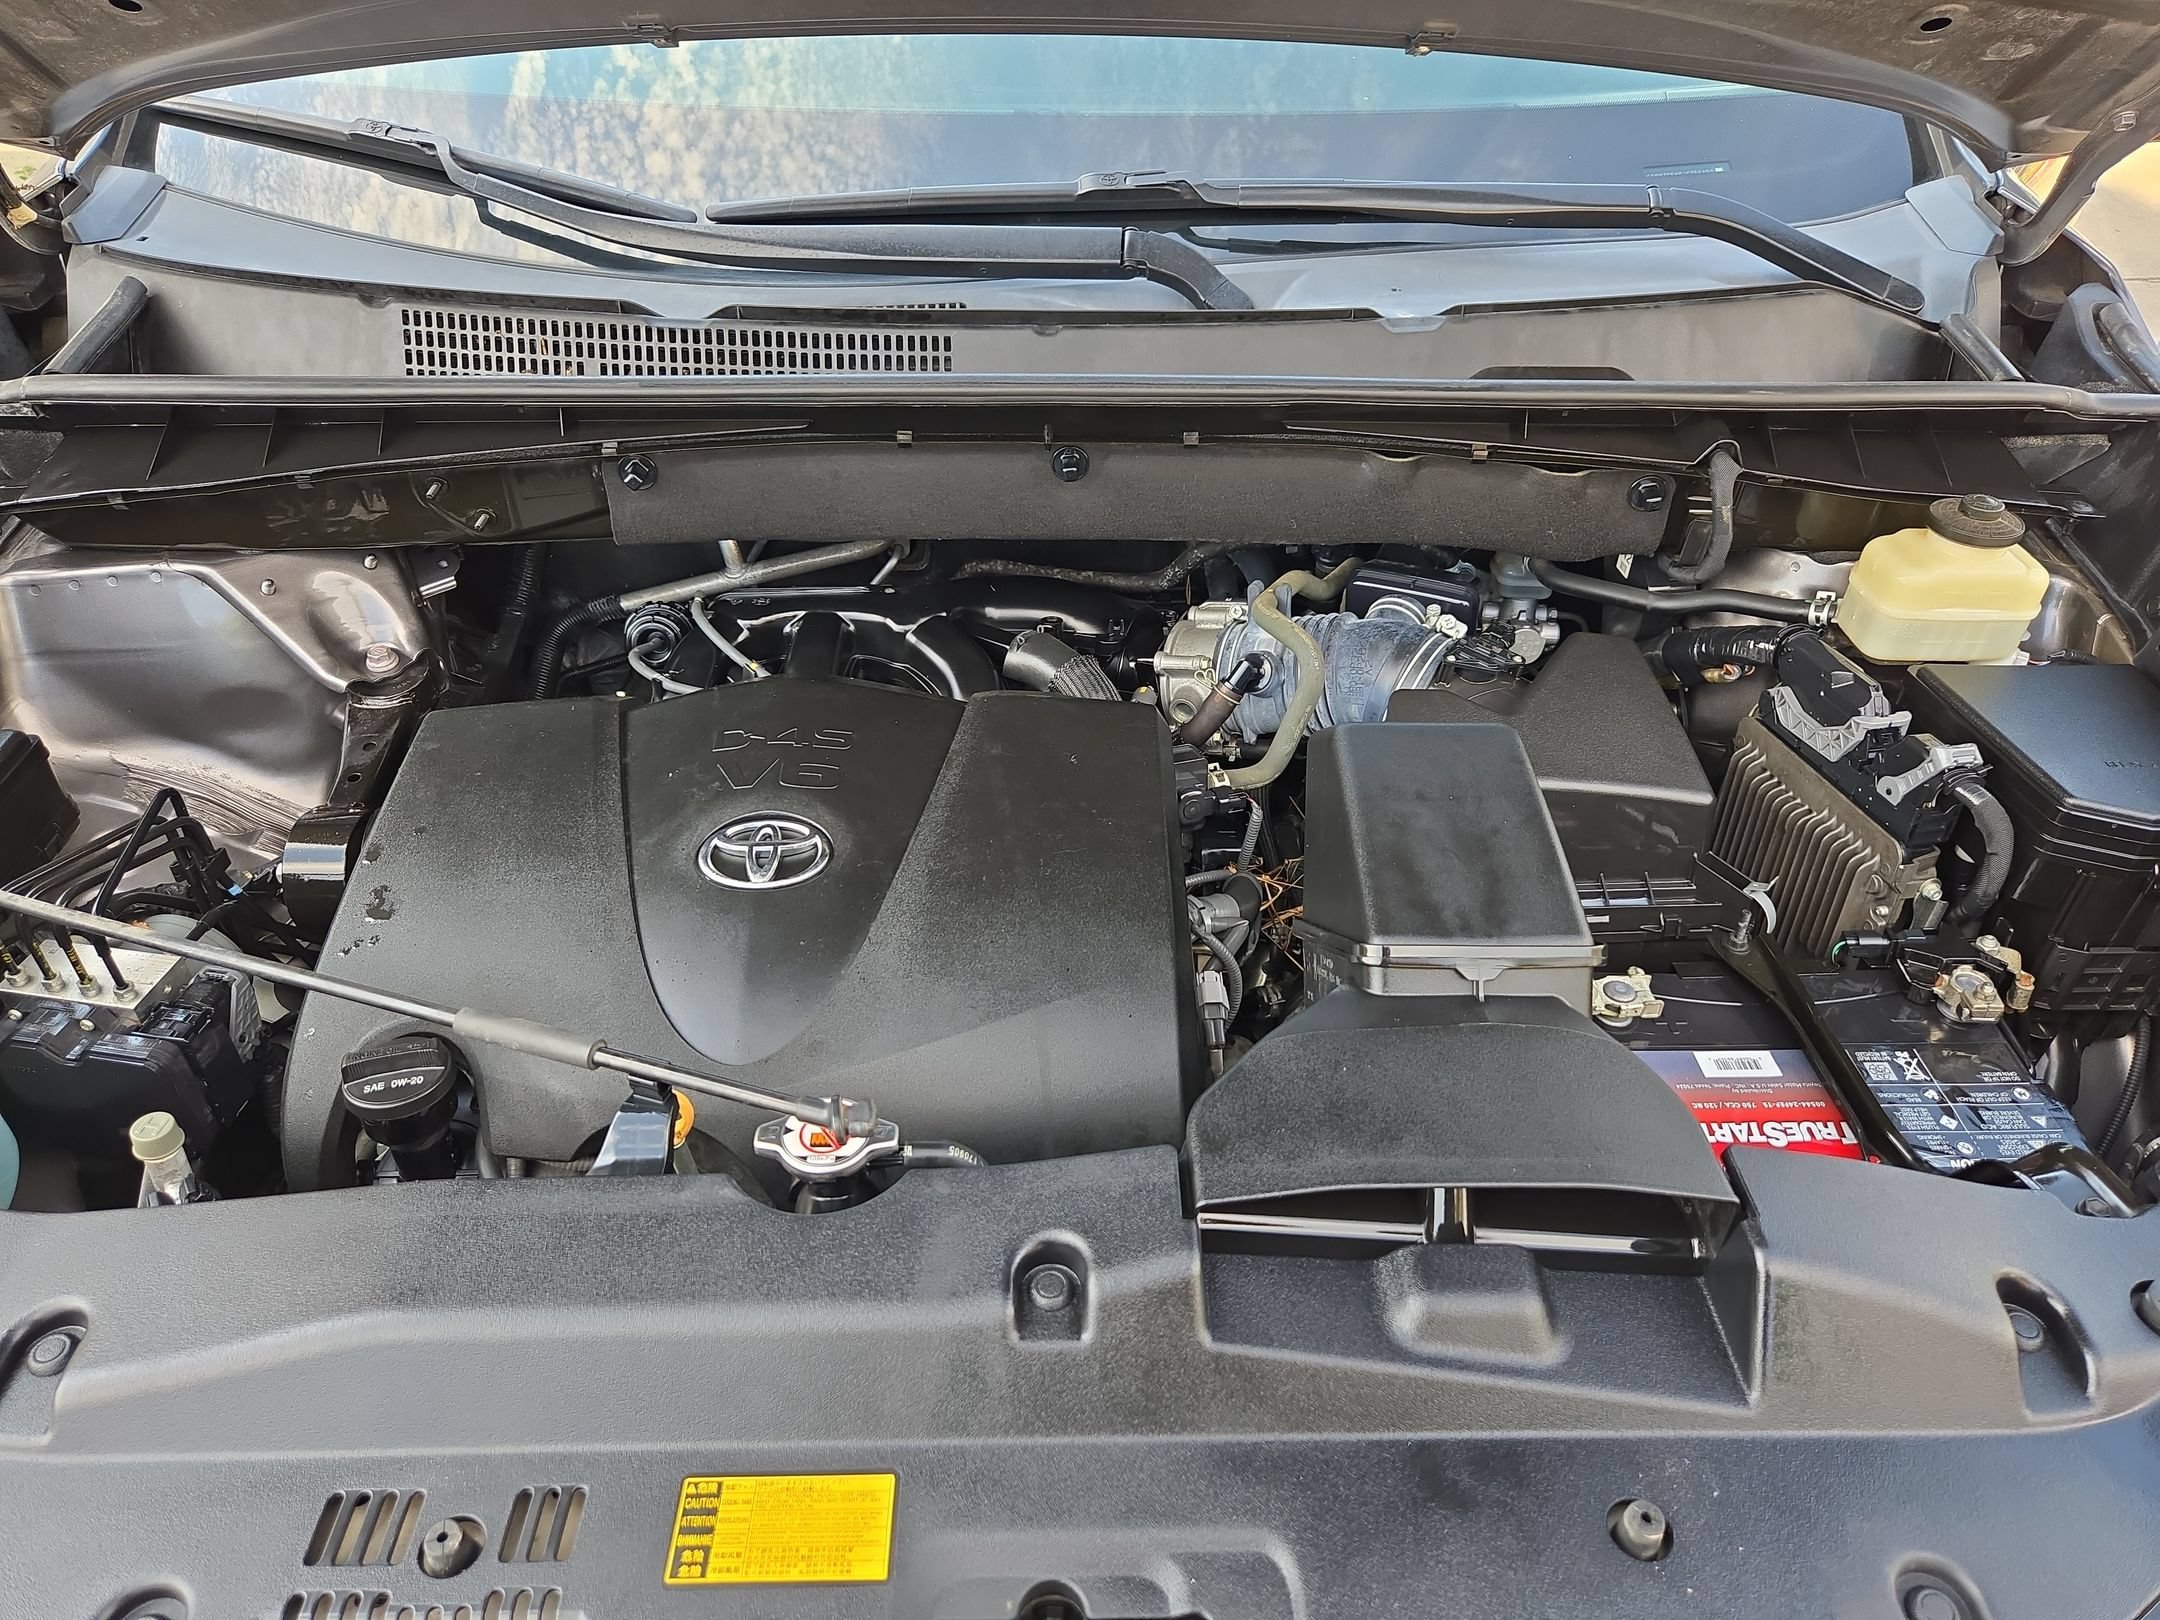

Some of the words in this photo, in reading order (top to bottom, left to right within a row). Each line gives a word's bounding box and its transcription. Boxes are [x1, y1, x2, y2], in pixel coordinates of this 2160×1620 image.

[711, 727, 854, 752] D-4S
[716, 757, 840, 790] V6
[362, 1081, 386, 1095] SAE
[390, 1075, 425, 1088] 0W-20
[1740, 1087, 1774, 1095] Distributed
[948, 1145, 978, 1165] 170905
[685, 1496, 721, 1510] CAUTION
[681, 1515, 718, 1529] ATTENTION
